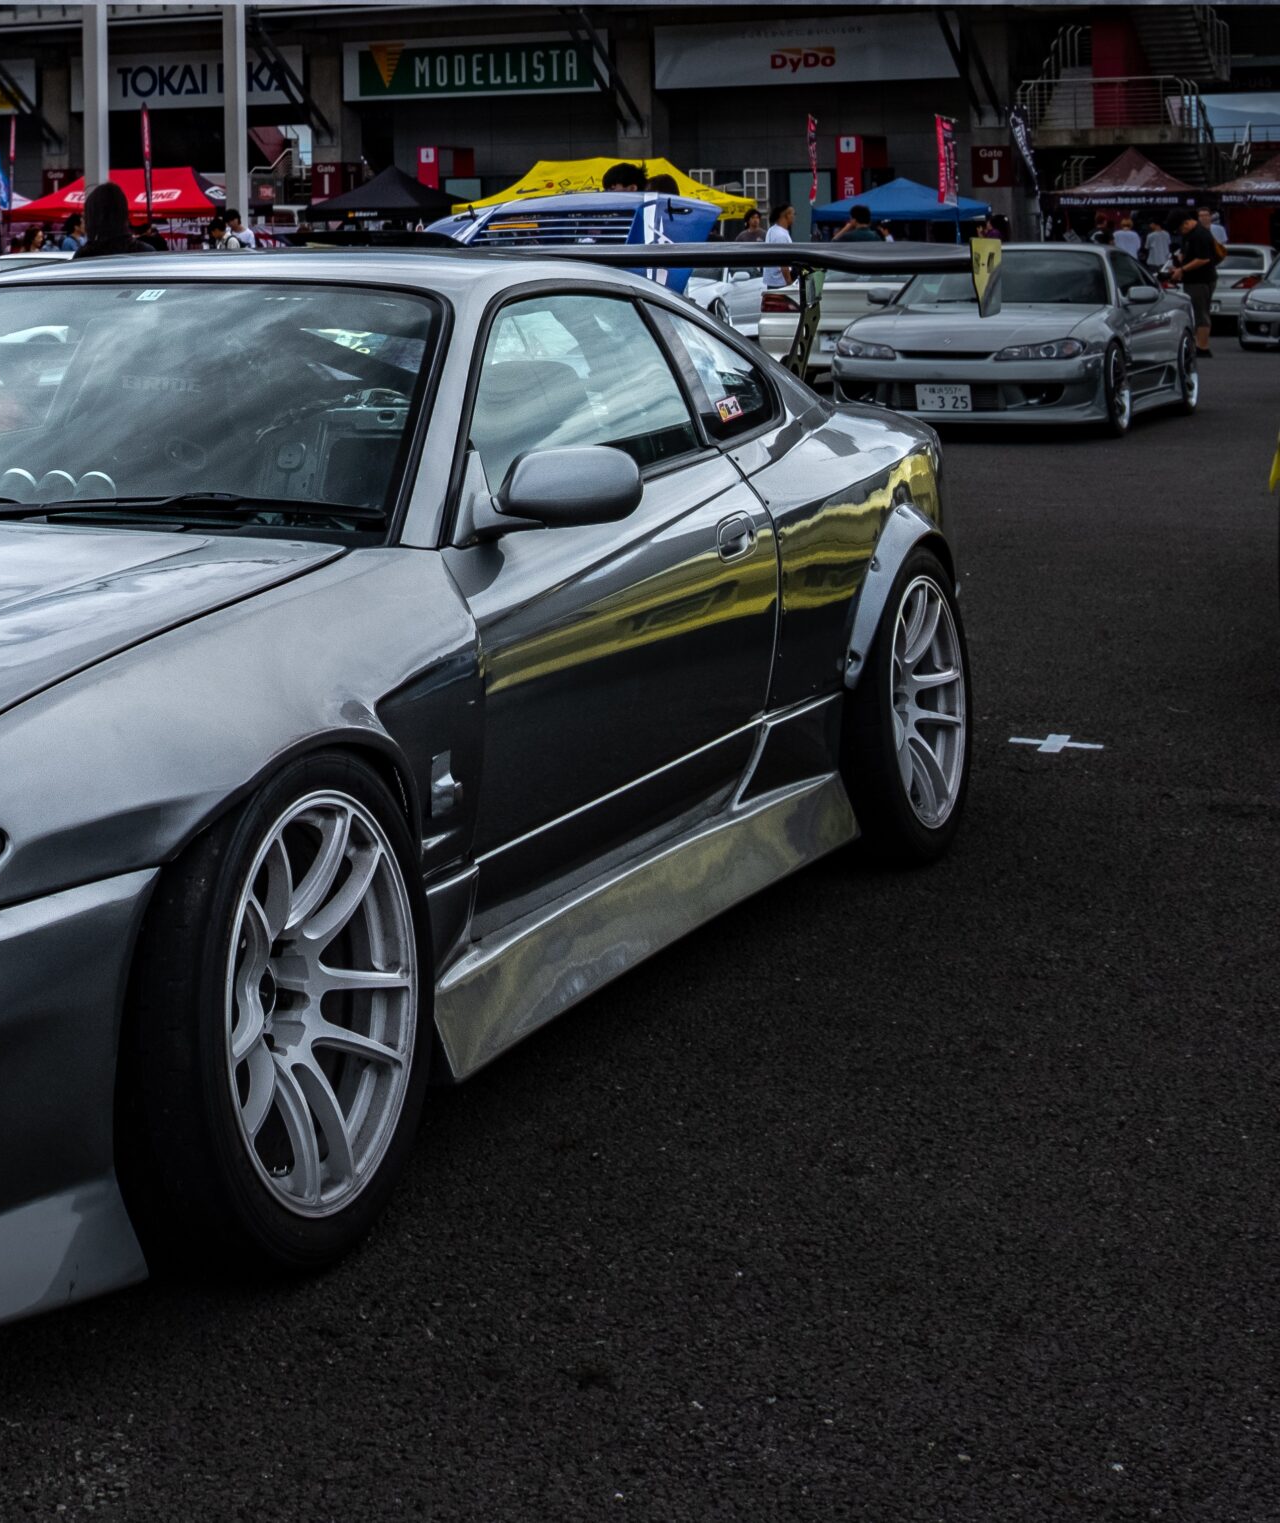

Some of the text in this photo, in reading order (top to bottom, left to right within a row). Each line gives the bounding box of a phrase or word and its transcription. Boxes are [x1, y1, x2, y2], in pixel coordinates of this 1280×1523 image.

[414, 49, 578, 88] MODELLISTA
[771, 53, 835, 73] DyDo
[117, 64, 208, 97] TOKAI
[979, 148, 1003, 158] Gate
[983, 159, 999, 184] J
